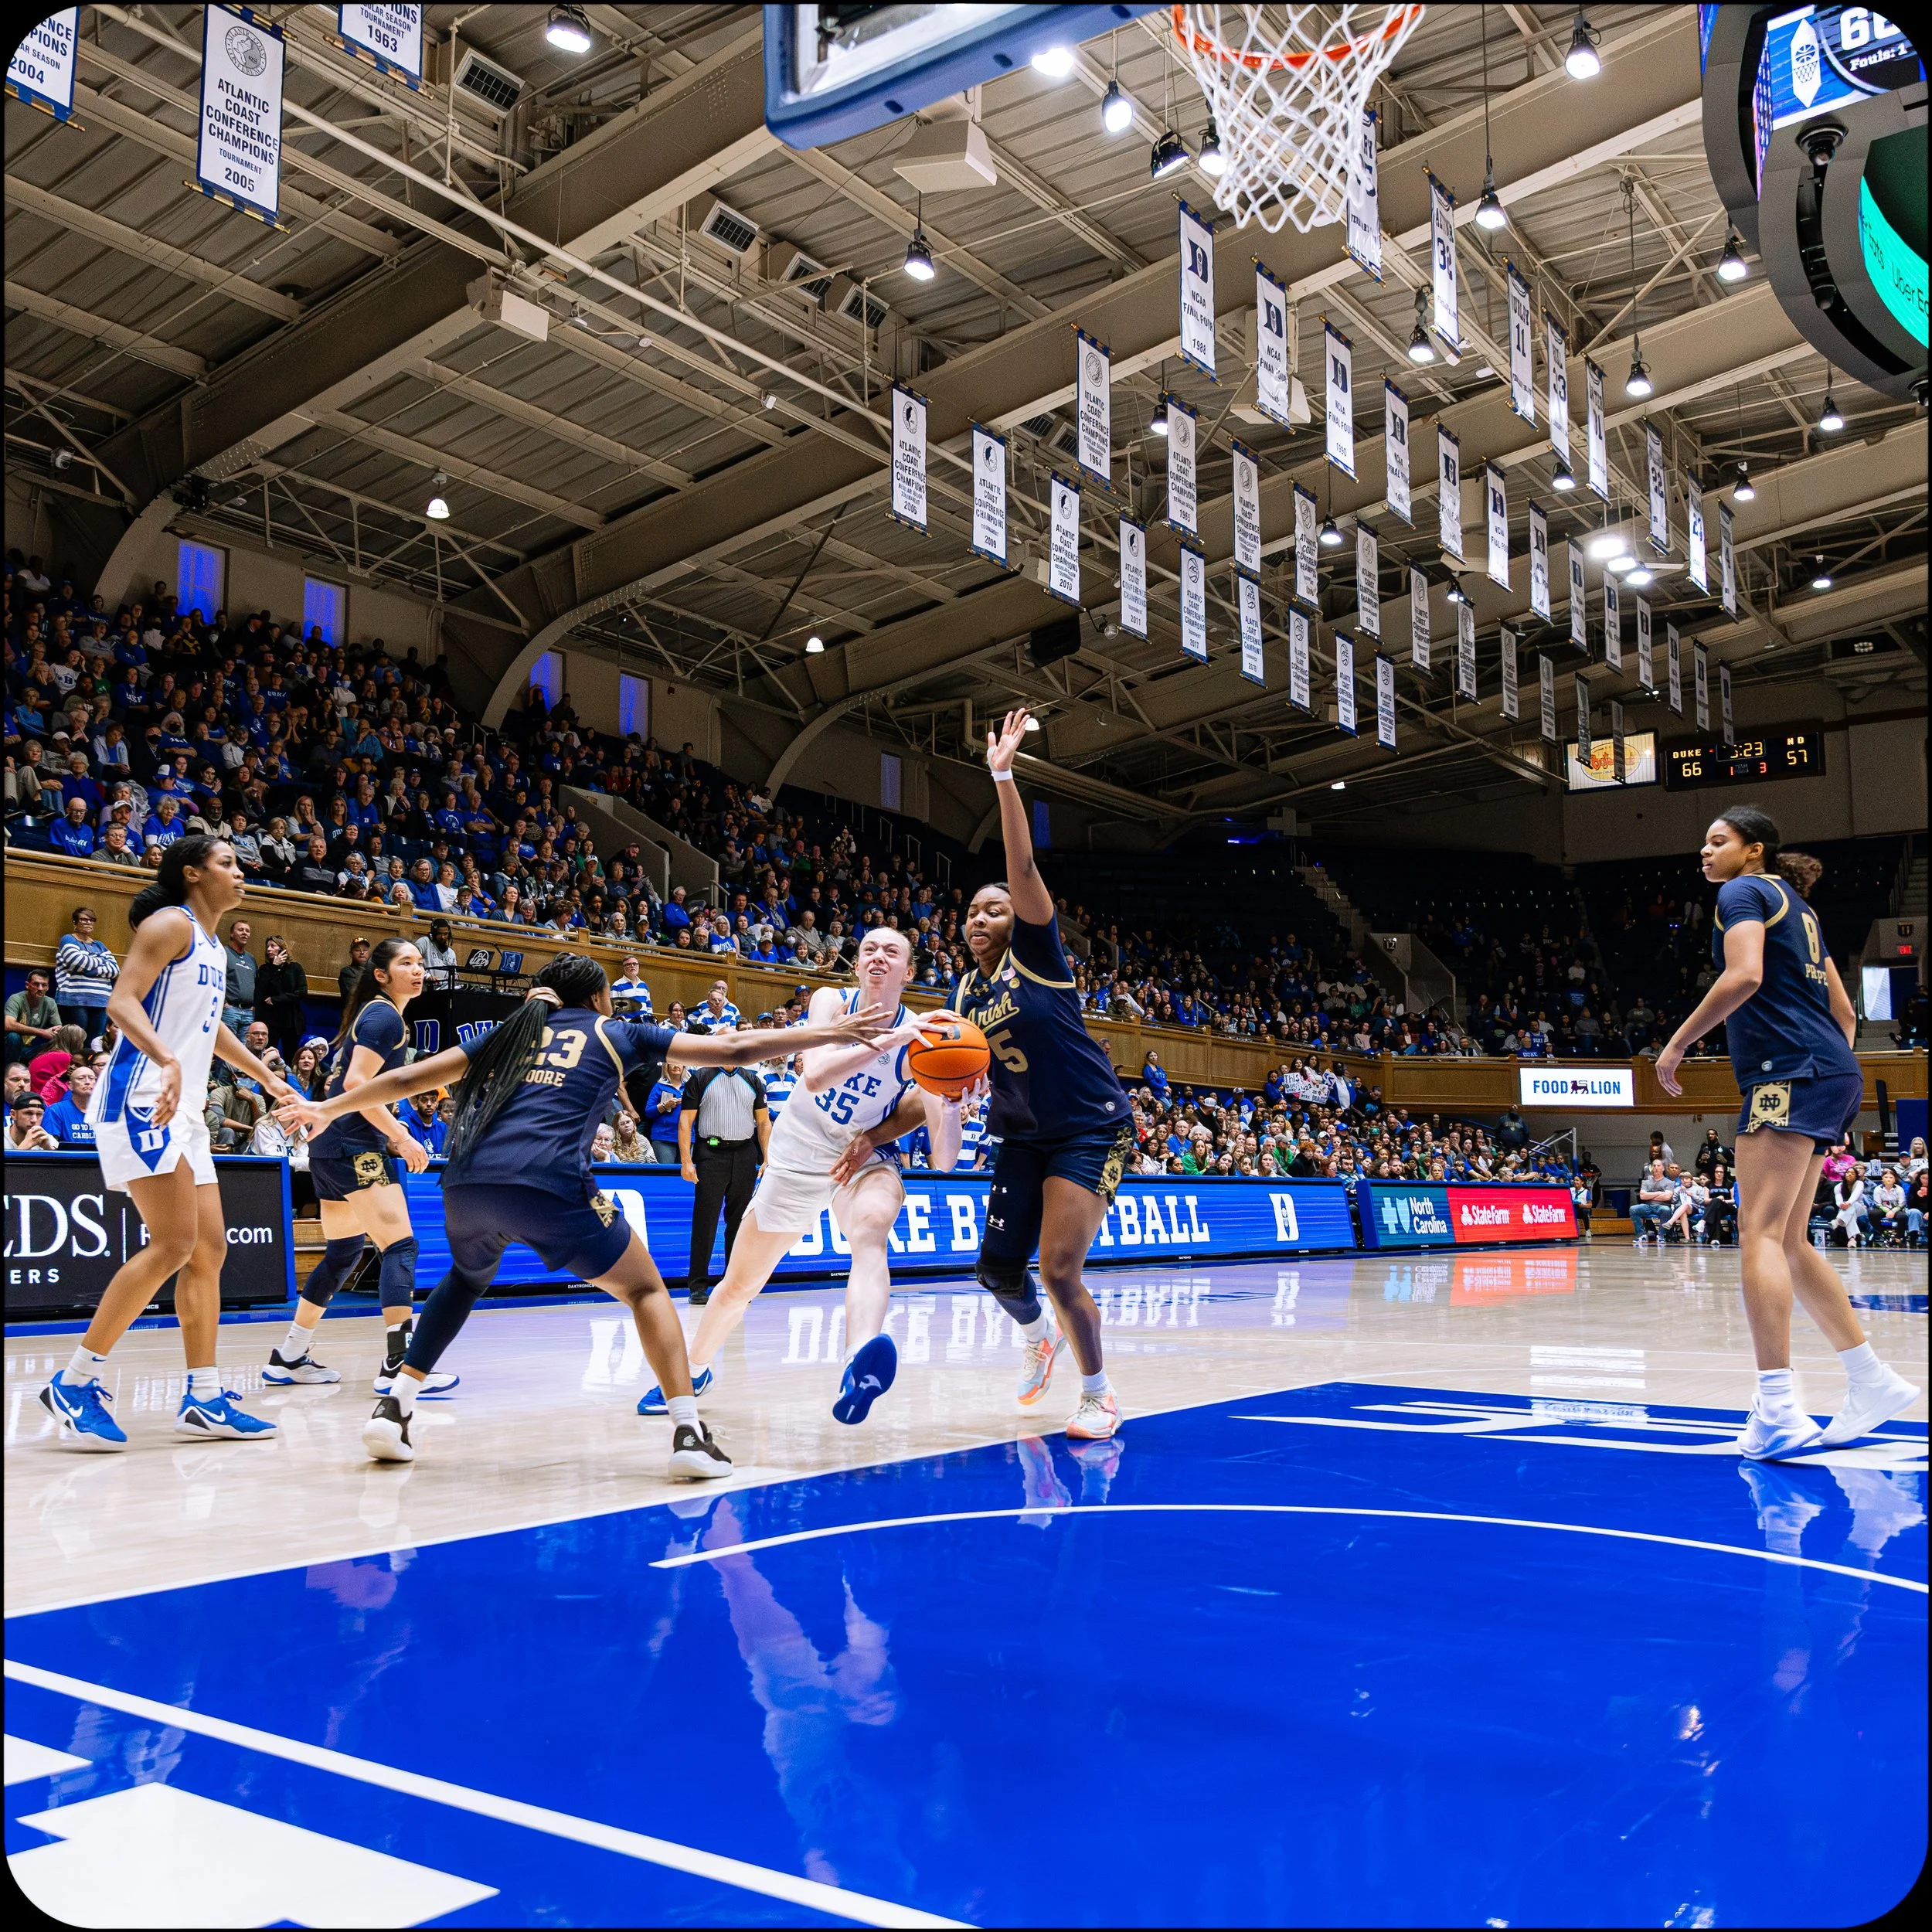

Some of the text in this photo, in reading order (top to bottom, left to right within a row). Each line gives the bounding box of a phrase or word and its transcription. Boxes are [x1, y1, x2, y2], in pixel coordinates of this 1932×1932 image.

[360, 7, 405, 39] TOURNAMENT
[385, 12, 411, 32] SEASON
[368, 25, 398, 53] 1963
[32, 49, 61, 70] SEASON
[1850, 43, 1908, 72] Fouls: 1
[10, 56, 44, 84] 2004
[218, 78, 270, 114] ATLANTIC
[225, 98, 261, 126] COAST
[206, 104, 278, 151] CONFERENCE
[209, 123, 274, 165] CHAMPIONS
[219, 148, 262, 175] TOURNAMENT
[224, 167, 255, 192] 2005
[1892, 263, 1913, 304] Uber
[1192, 291, 1206, 308] NCAA
[1182, 302, 1199, 321] FINAL
[1515, 323, 1526, 358] 11
[1267, 345, 1281, 362] NCAA
[1085, 390, 1104, 410] ATLANTIC
[1335, 400, 1346, 416] NCAA
[1087, 403, 1102, 420] COAST
[1328, 411, 1341, 427] FINAL
[1080, 410, 1109, 436] CONFERENCE
[1082, 423, 1108, 447] CHAMPIONS
[899, 440, 921, 458] ATLANTIC
[902, 453, 918, 468] COAST
[1089, 454, 1102, 468] 1964
[1173, 451, 1192, 469] ATLANTIC
[895, 459, 926, 483] CONFERENCE
[1176, 464, 1189, 478] COAST
[896, 472, 925, 494] CHAMPIONS
[979, 478, 1002, 495] ATLANTIC
[1170, 471, 1196, 492] CONFERENCE
[984, 490, 998, 504] COAST
[1171, 482, 1196, 502] CHAMPIONS
[975, 497, 1005, 519] CONFERENCE
[975, 509, 1004, 529] CHAMPIONS
[985, 536, 997, 548] 2009
[1056, 524, 1075, 541] ATLANTIC
[1060, 536, 1072, 549] COAST
[1236, 525, 1259, 543] CHAMPIONS
[1053, 554, 1078, 572] CHAMPIONS
[1060, 579, 1073, 591] 2010
[1131, 614, 1141, 625] 2011
[1672, 749, 1702, 759] DUKE
[1787, 749, 1808, 765] 57
[1682, 762, 1702, 777] 66
[1759, 762, 1767, 774] 3
[202, 995, 218, 1033] 3
[526, 1070, 566, 1087] OORE
[1533, 1080, 1621, 1094] FOOD LION
[815, 1088, 860, 1125] 35
[1410, 1196, 1434, 1216] North
[1413, 1214, 1447, 1234] Carolina
